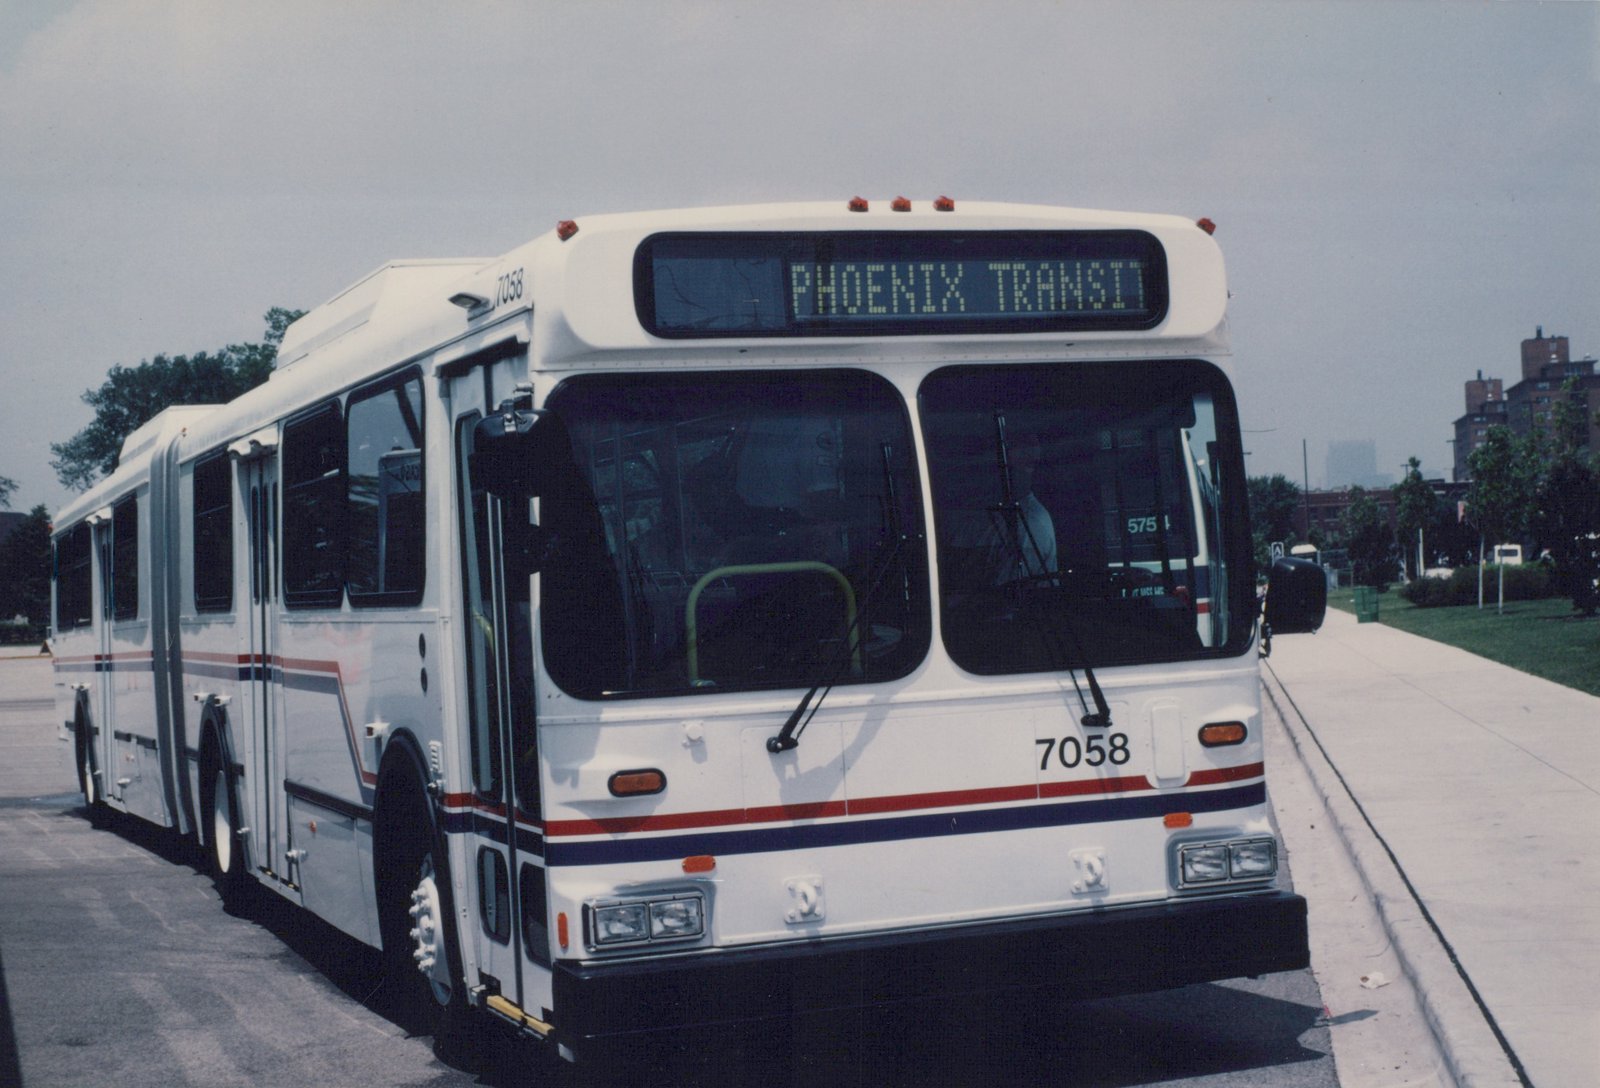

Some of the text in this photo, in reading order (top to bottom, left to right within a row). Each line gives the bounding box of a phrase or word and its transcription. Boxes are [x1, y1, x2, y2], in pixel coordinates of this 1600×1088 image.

[496, 267, 524, 307] 7058
[792, 263, 965, 314] PHOENIX
[1035, 732, 1130, 770] 7058
